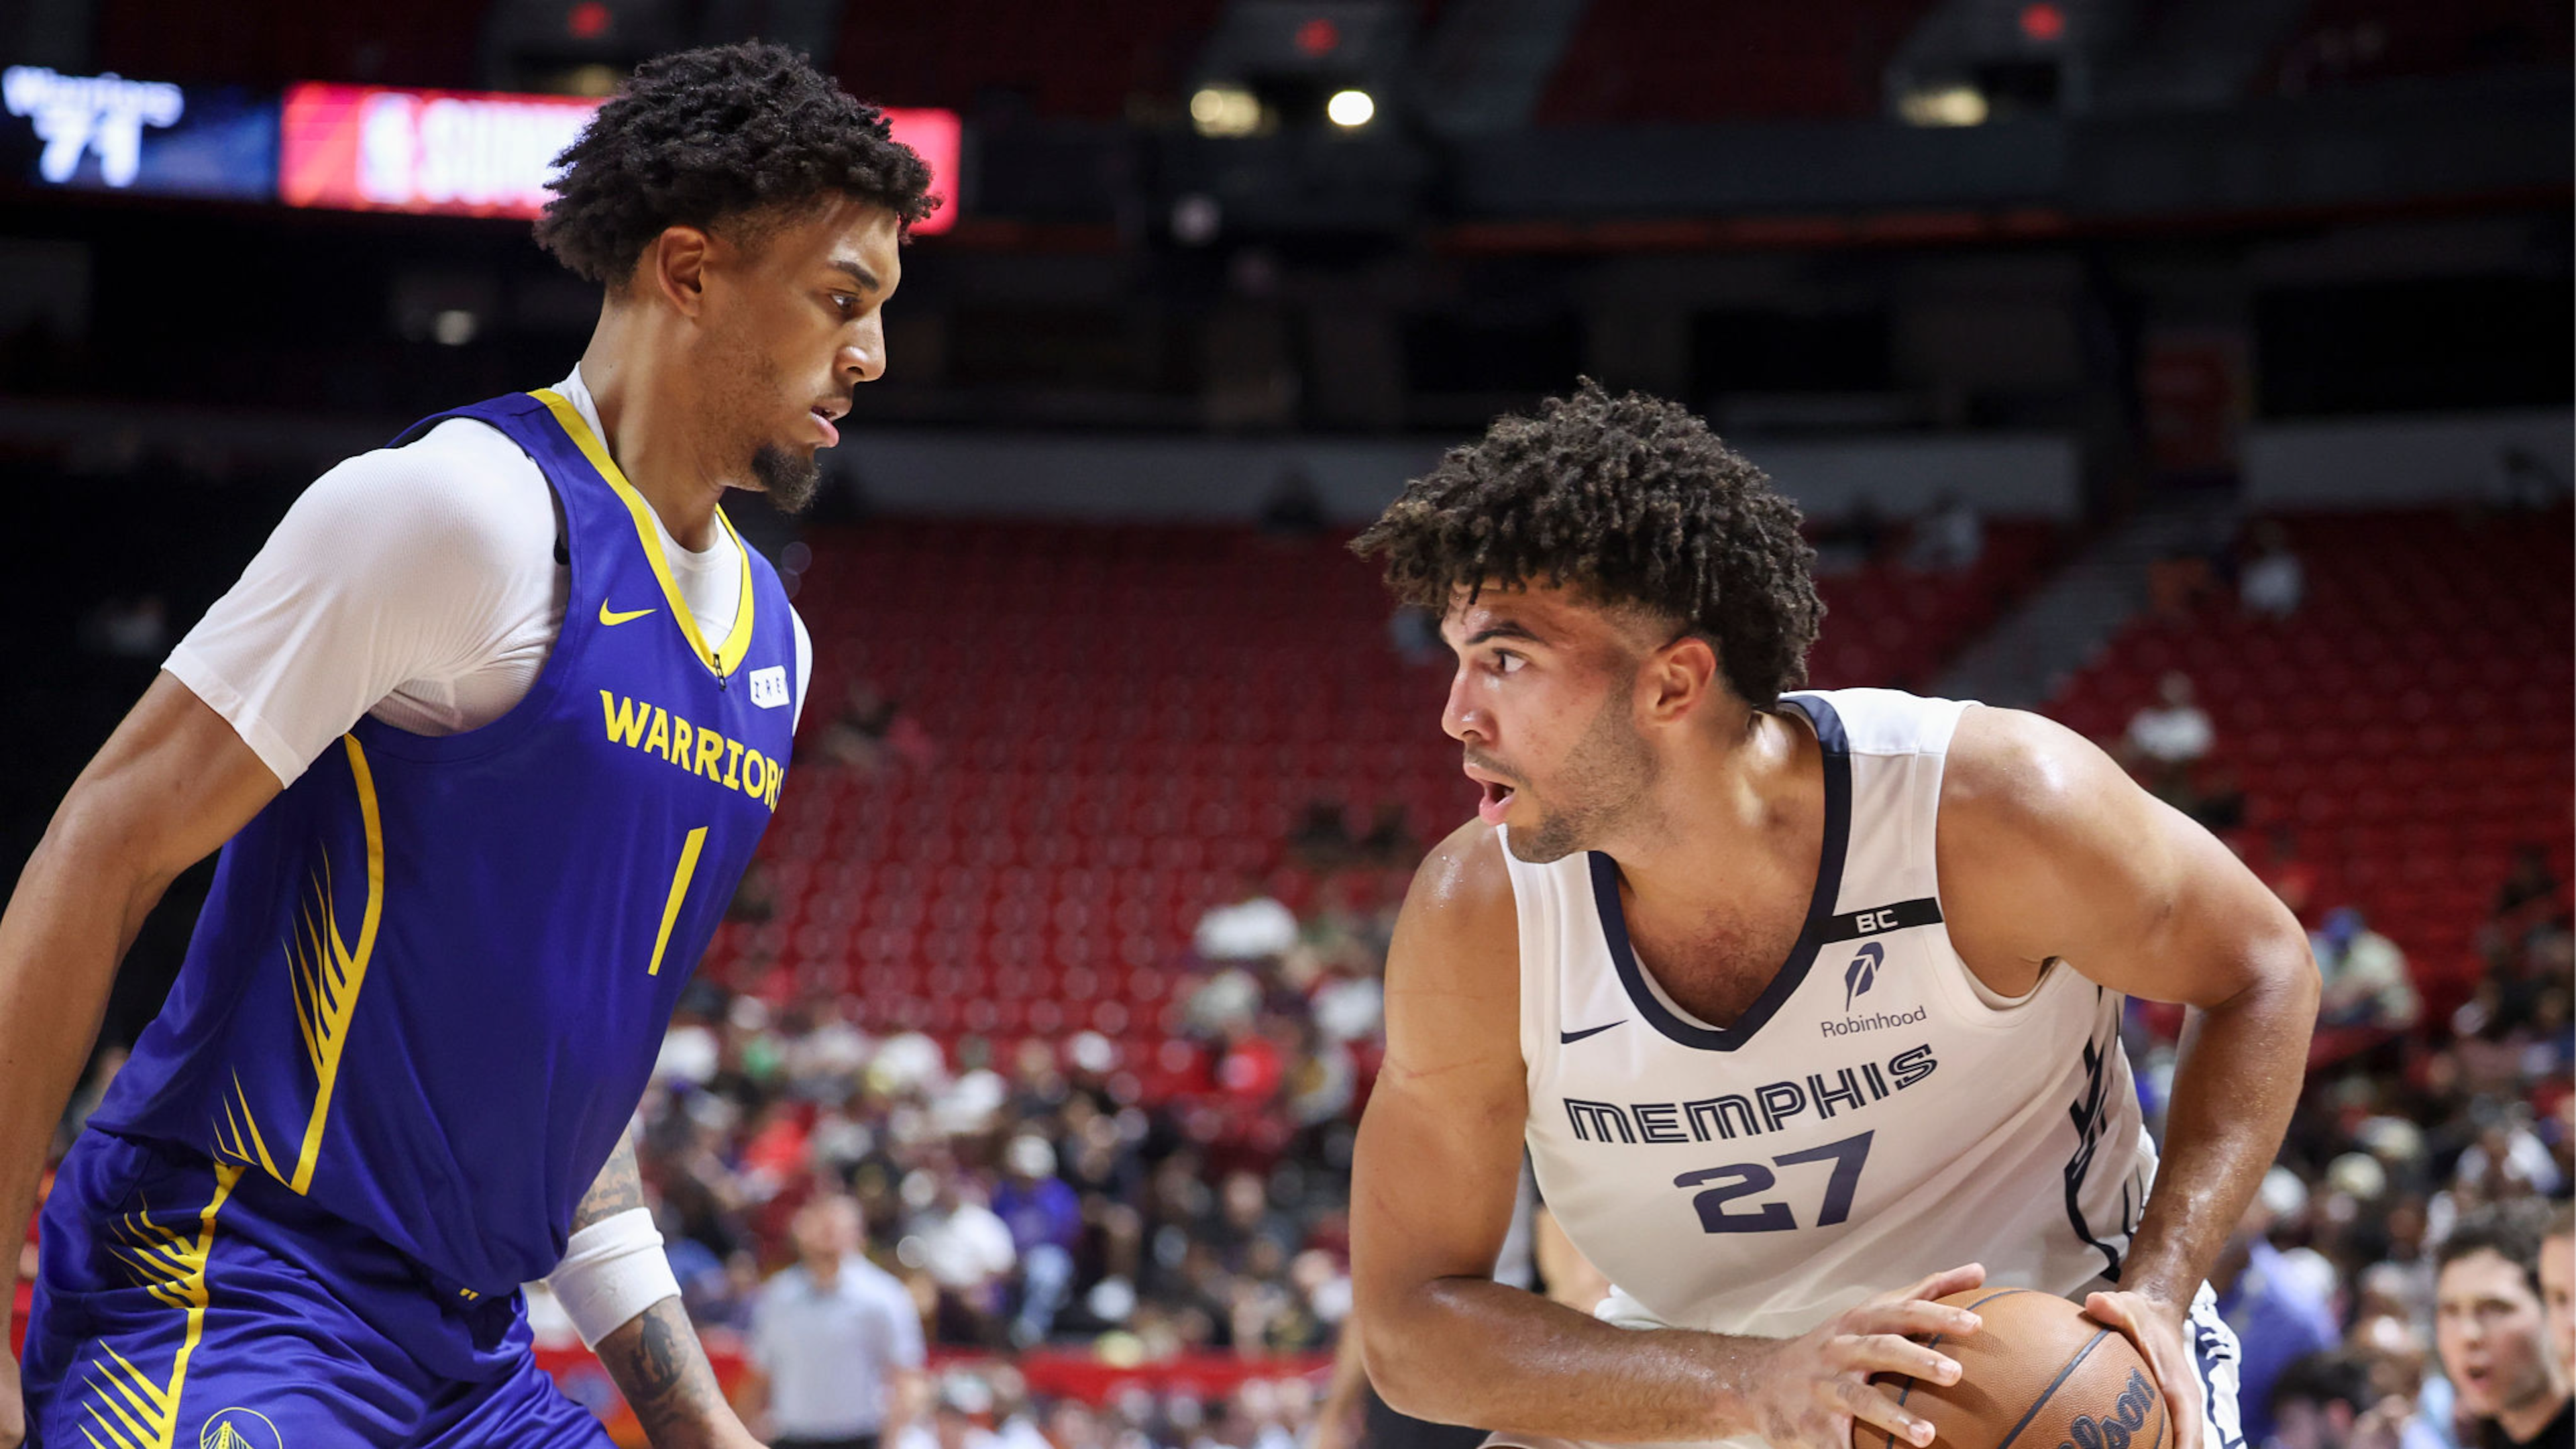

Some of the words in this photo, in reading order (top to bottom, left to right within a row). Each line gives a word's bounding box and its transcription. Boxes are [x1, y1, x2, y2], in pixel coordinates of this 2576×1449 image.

[599, 689, 784, 814] WARRIOR
[647, 826, 709, 976] 1
[1856, 908, 1899, 934] BC
[1821, 1005, 1927, 1038] Robinhood
[1562, 1043, 1939, 1144] MEMPHIS
[1673, 1129, 1876, 1234] 27
[2058, 1366, 2155, 1449] lson
